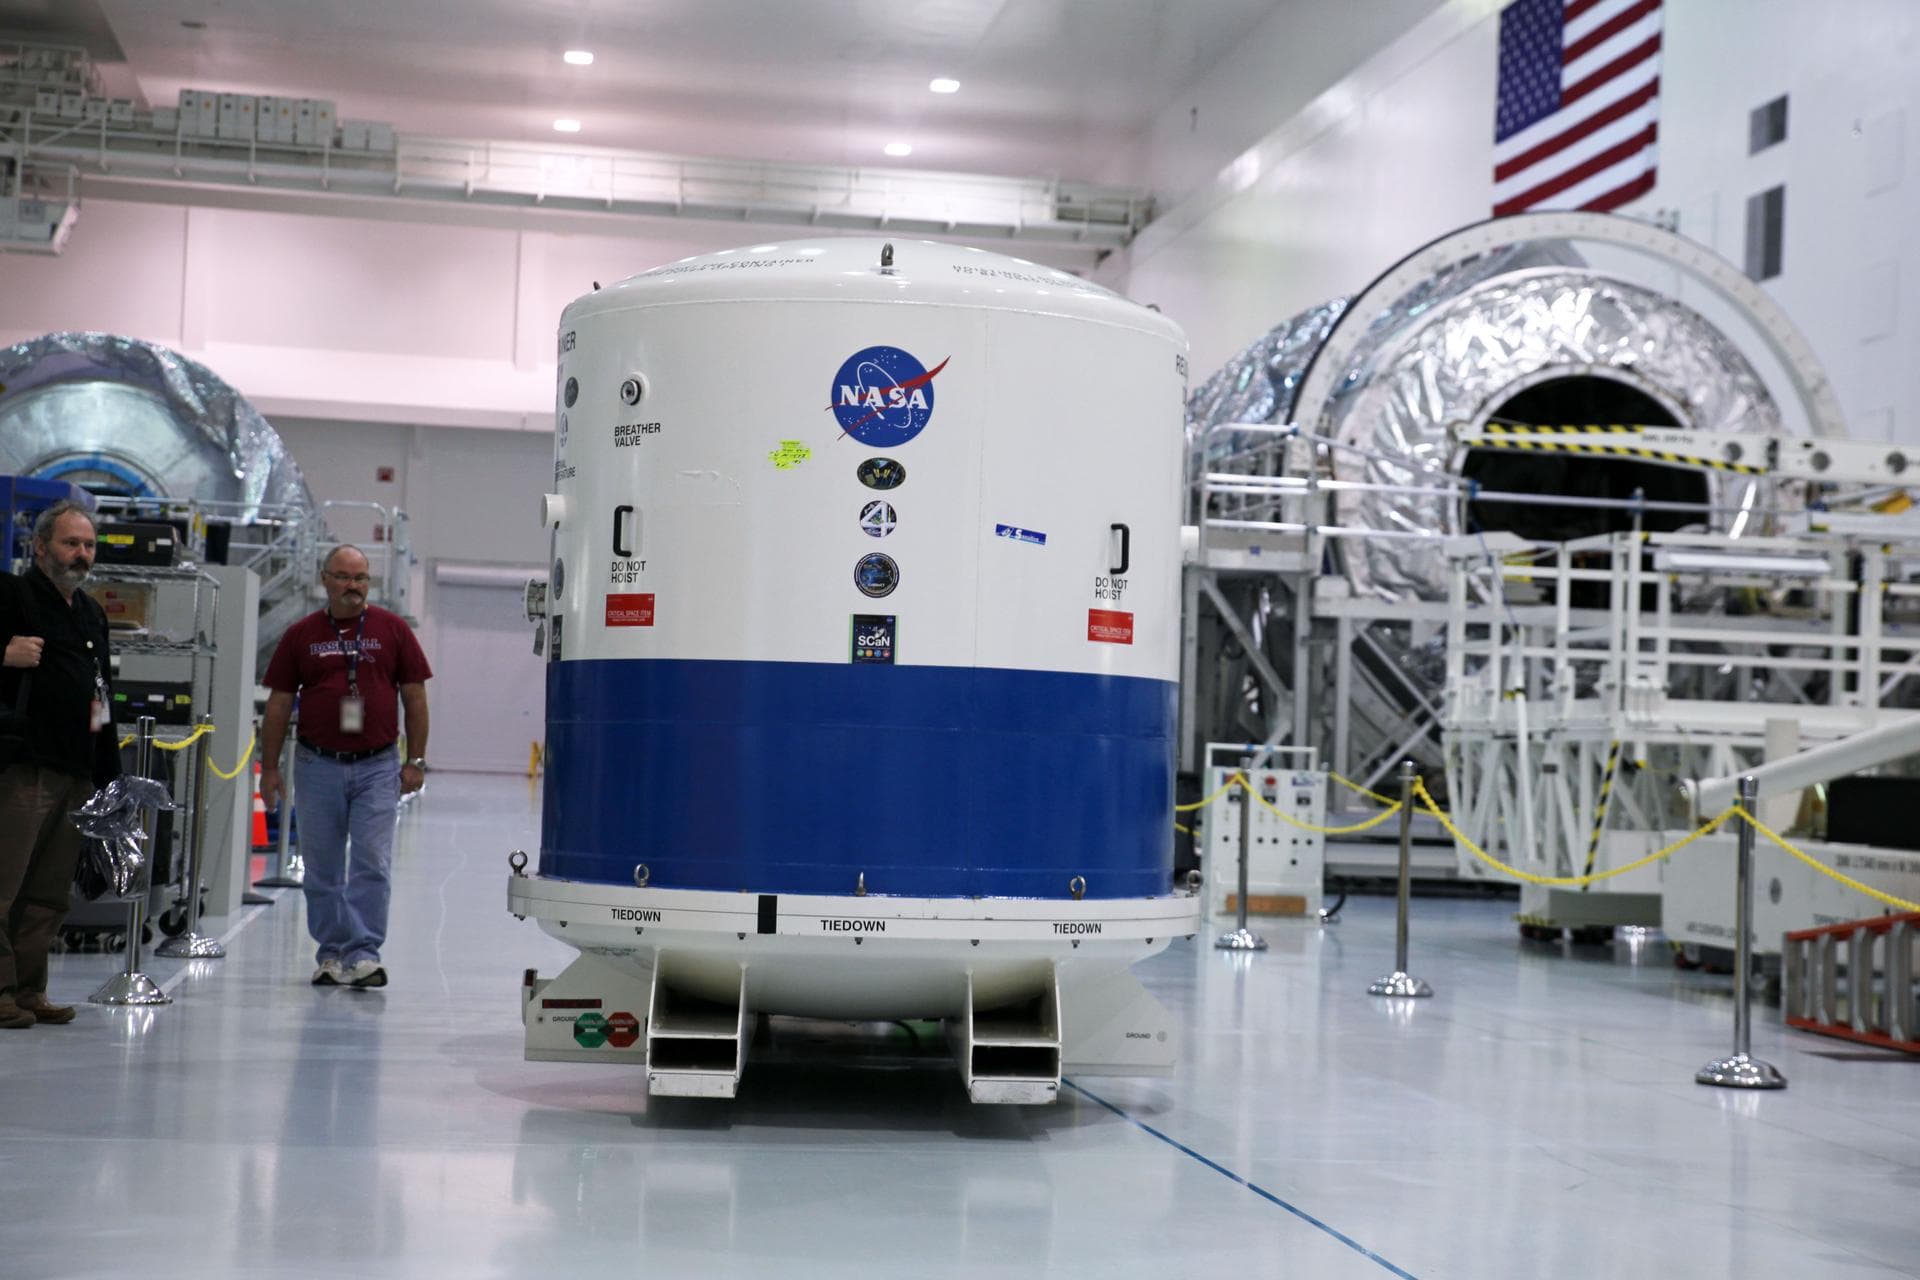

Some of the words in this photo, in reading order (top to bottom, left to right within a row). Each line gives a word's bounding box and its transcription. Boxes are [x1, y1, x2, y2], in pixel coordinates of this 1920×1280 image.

[840, 385, 929, 410] NASA
[614, 422, 661, 437] BREATHER
[614, 435, 641, 448] VALVE
[611, 561, 625, 572] DO
[627, 560, 647, 571] NOT
[611, 572, 638, 584] HOIST
[1095, 576, 1109, 588] DO
[1111, 578, 1128, 590] NOT
[1095, 588, 1122, 600] HOIST
[858, 635, 890, 647] SCaN
[611, 908, 661, 922] TIEDOWN
[820, 919, 886, 932] TIEDOWN
[1052, 922, 1102, 934] TIEDOWN
